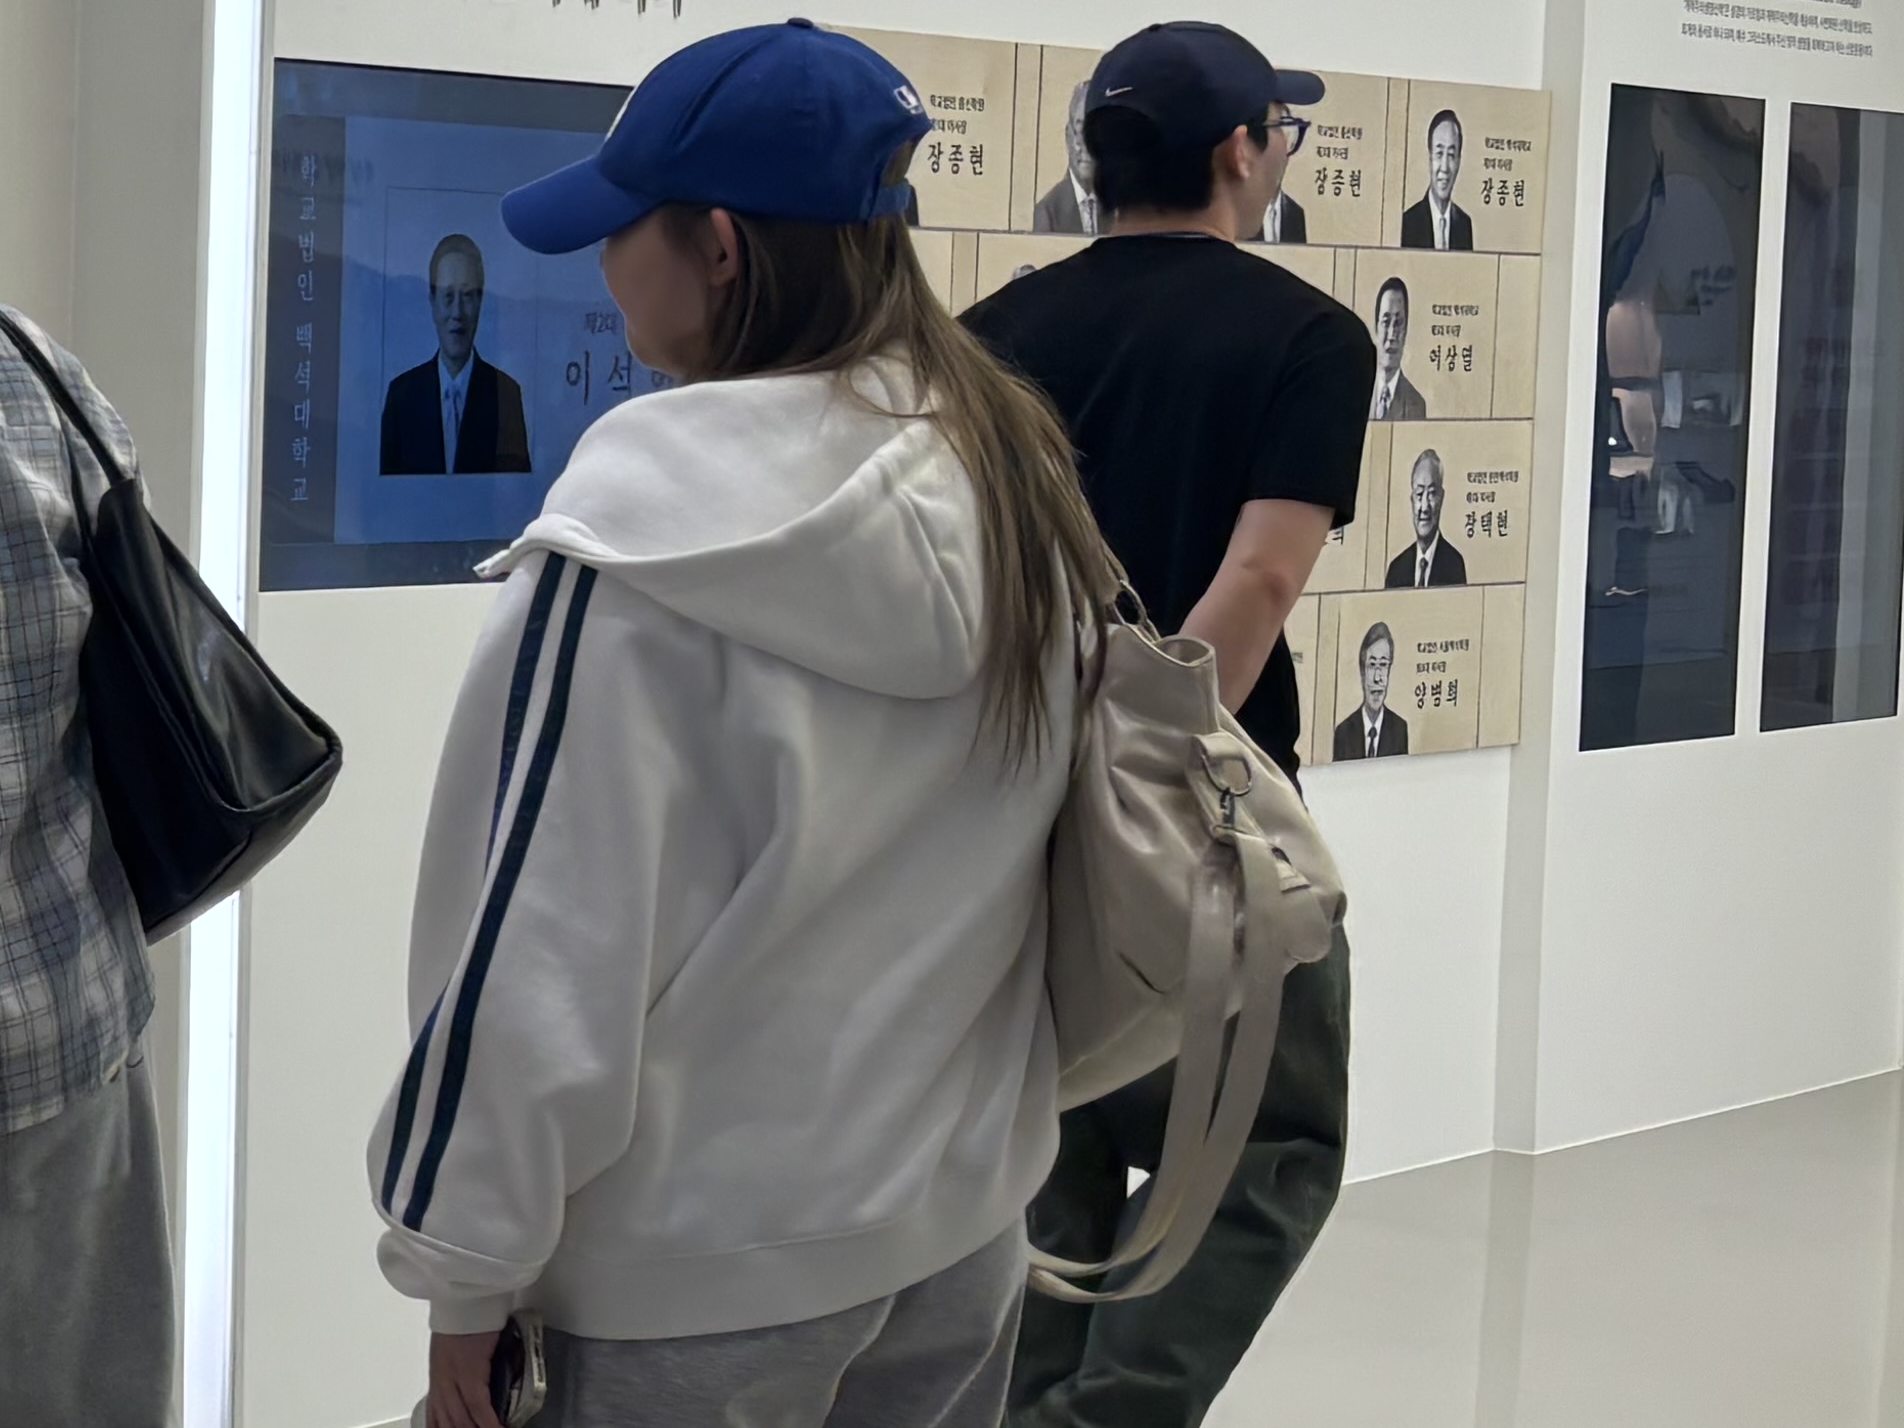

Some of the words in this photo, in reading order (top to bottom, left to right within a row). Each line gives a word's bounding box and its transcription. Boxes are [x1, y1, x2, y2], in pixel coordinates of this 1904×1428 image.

[927, 142, 983, 176] 장종현
[1315, 167, 1361, 197] 장종현
[1481, 177, 1525, 207] 장종현
[291, 323, 313, 501] 백석대학교
